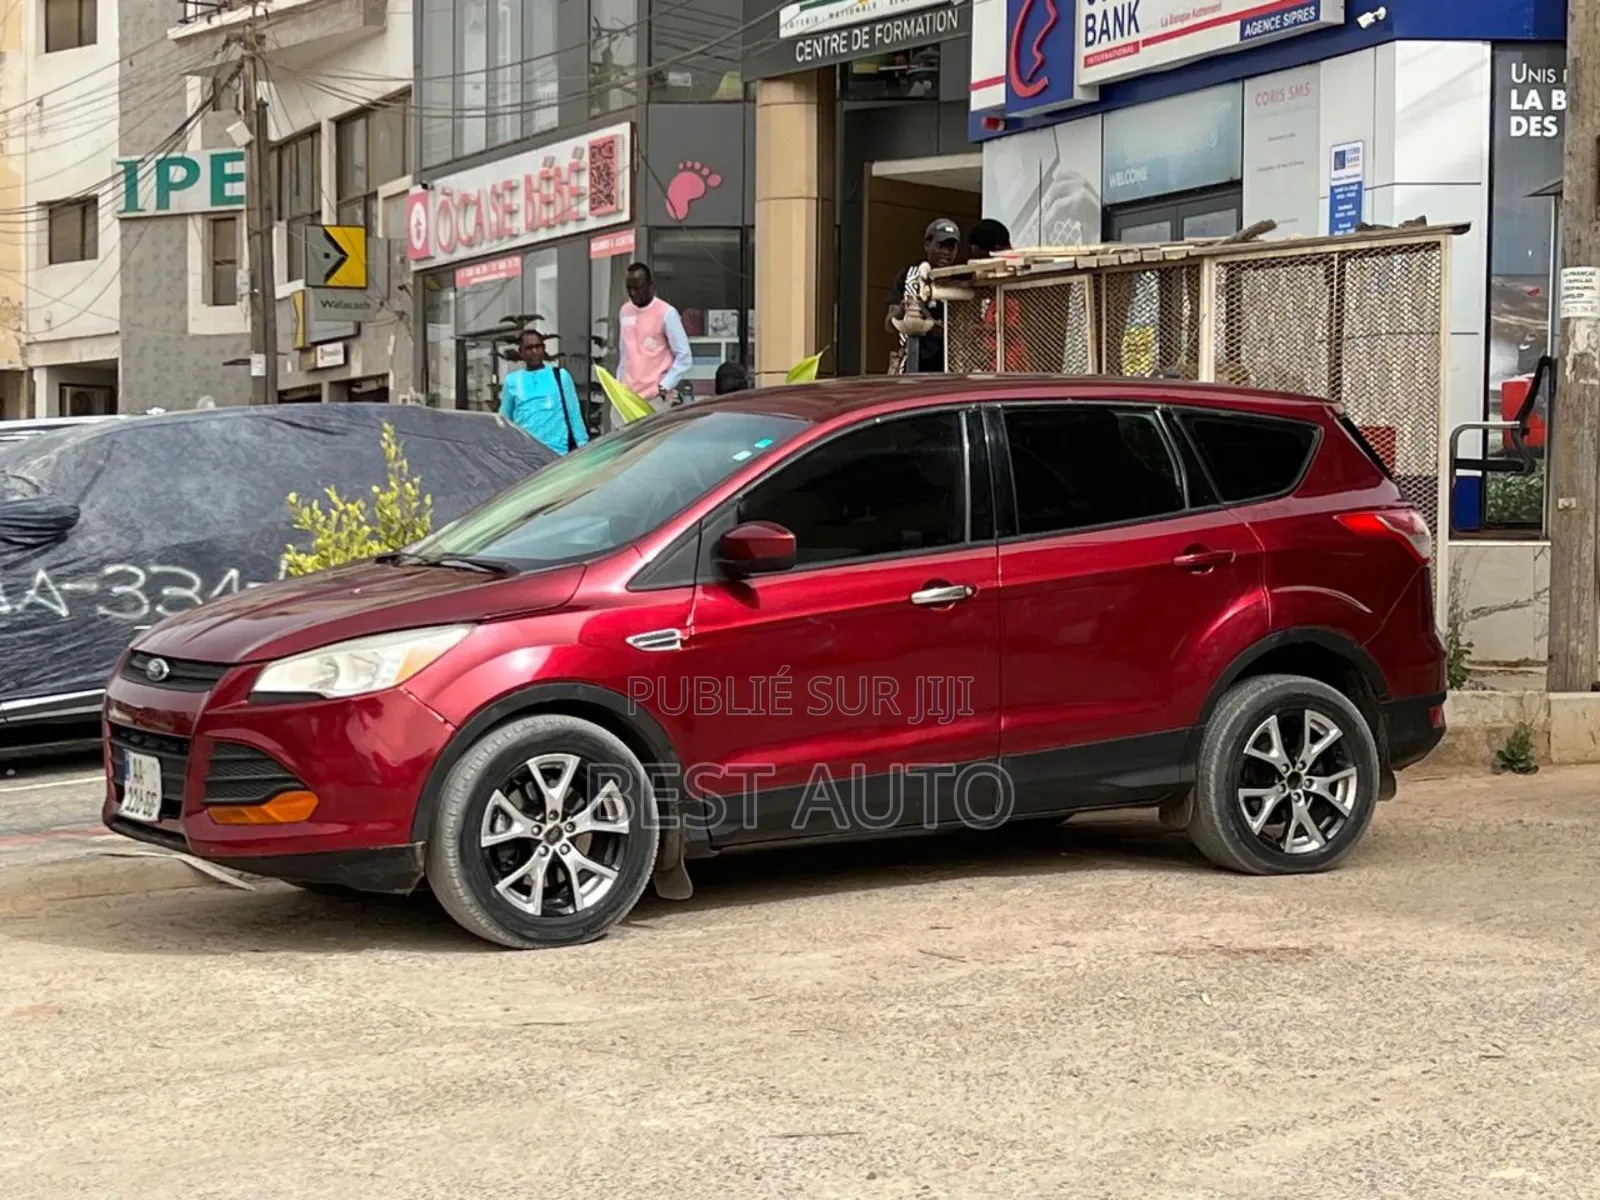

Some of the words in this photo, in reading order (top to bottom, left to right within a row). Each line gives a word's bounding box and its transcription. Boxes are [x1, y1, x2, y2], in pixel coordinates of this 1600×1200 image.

[795, 32, 848, 62] CENTRE
[852, 27, 870, 51] DE
[874, 8, 959, 46] FORMATION
[1084, 0, 1140, 48] BANK
[1244, 15, 1281, 37] AGENCE
[1283, 5, 1316, 27] SIPRES
[1254, 87, 1286, 107] CORIS
[1288, 81, 1311, 100] SMS
[1510, 88, 1544, 111] LA
[1510, 115, 1559, 138] DES
[116, 151, 245, 213] IPE
[1108, 165, 1148, 188] WELCOME
